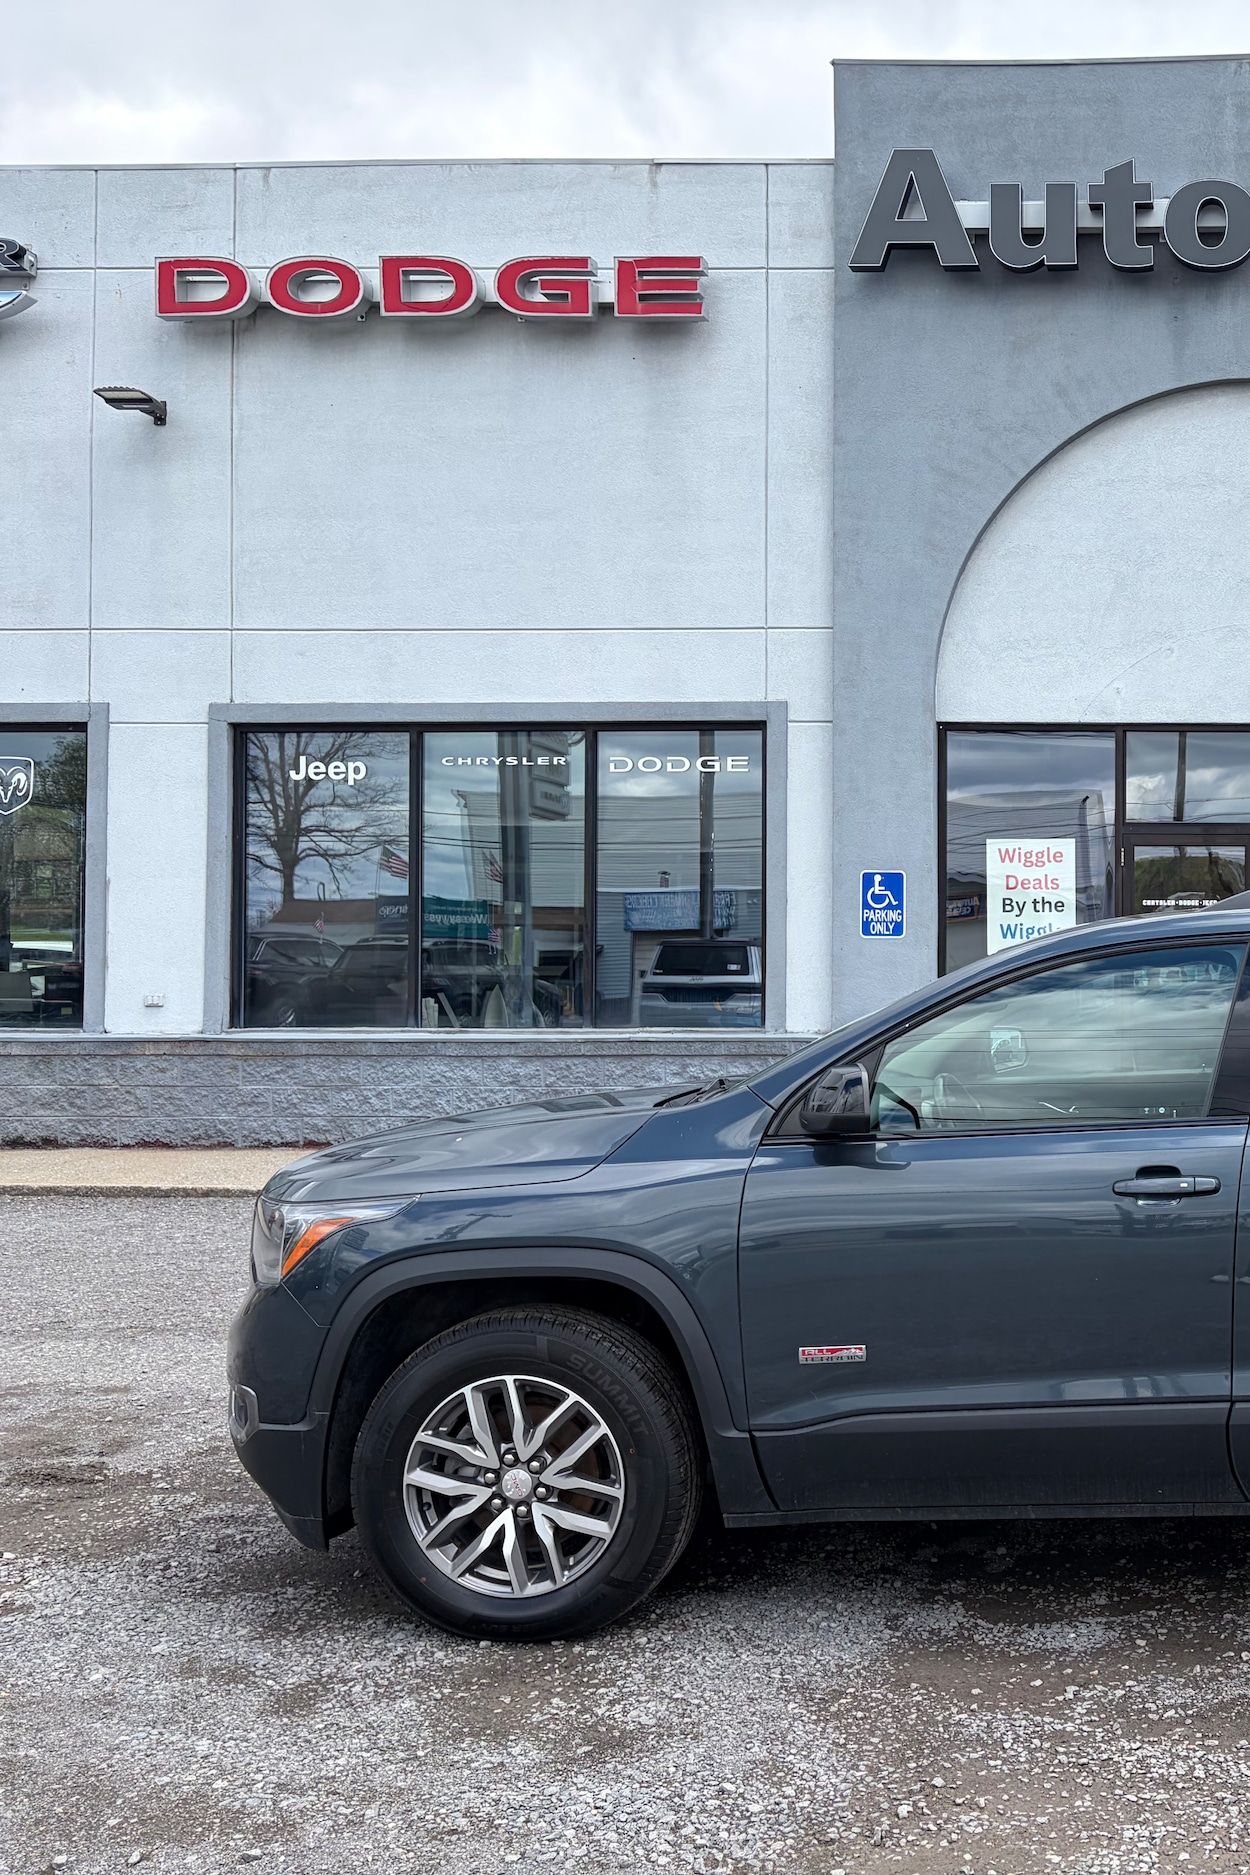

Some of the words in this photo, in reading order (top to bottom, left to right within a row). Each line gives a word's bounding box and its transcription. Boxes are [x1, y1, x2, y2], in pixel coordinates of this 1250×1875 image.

[154, 255, 708, 321] DODGE
[288, 755, 367, 785] Jeep
[441, 756, 568, 766] CHRYSLER
[608, 755, 751, 773] DODGE
[997, 847, 1064, 868] Wiggle
[1005, 874, 1060, 891] Deals
[1002, 897, 1027, 917] By
[1032, 896, 1065, 913] the
[863, 909, 902, 923] PARKING
[870, 921, 895, 935] ONLY
[999, 922, 1062, 940] Wiggl
[566, 1353, 651, 1436] SUMMIT
